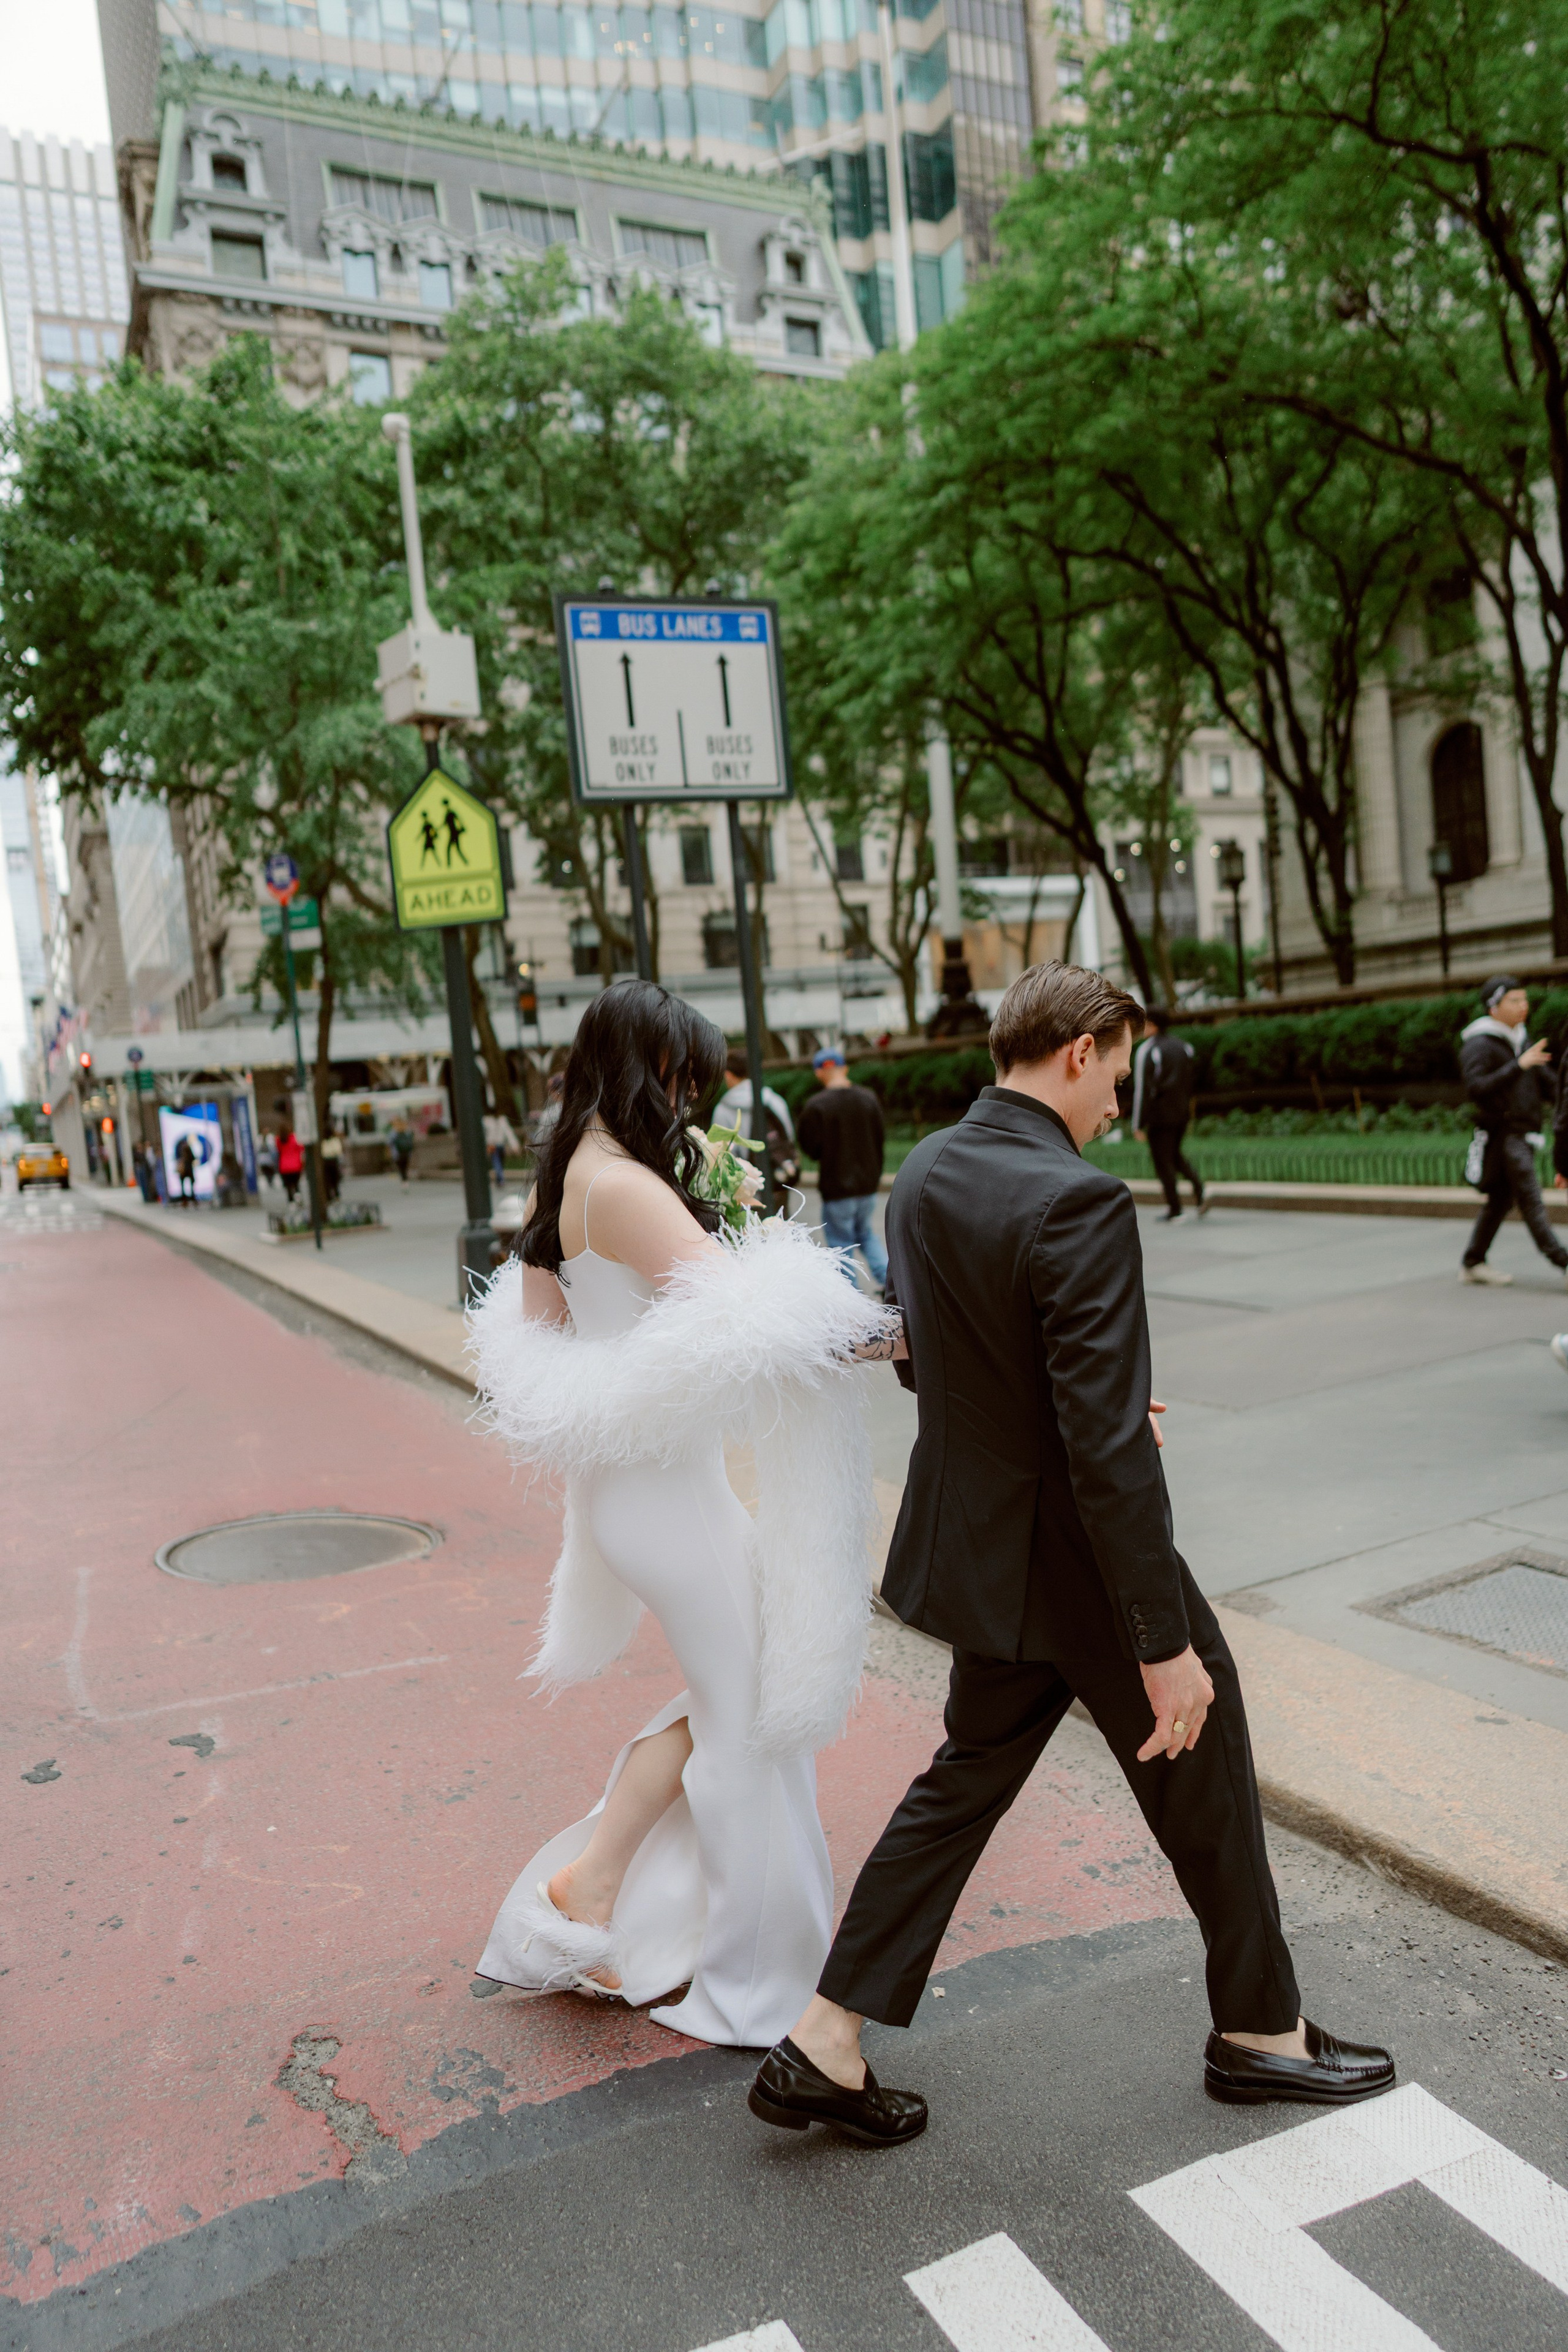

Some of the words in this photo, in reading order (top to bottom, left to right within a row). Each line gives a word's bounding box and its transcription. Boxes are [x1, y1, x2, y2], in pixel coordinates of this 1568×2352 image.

[618, 613, 657, 638] BUS
[662, 614, 723, 639] LANES
[609, 735, 658, 756] BUSES
[707, 734, 752, 755] BUSES
[616, 761, 655, 782] ONLY
[712, 761, 750, 780] ONLY
[410, 886, 492, 911] AHEAD
